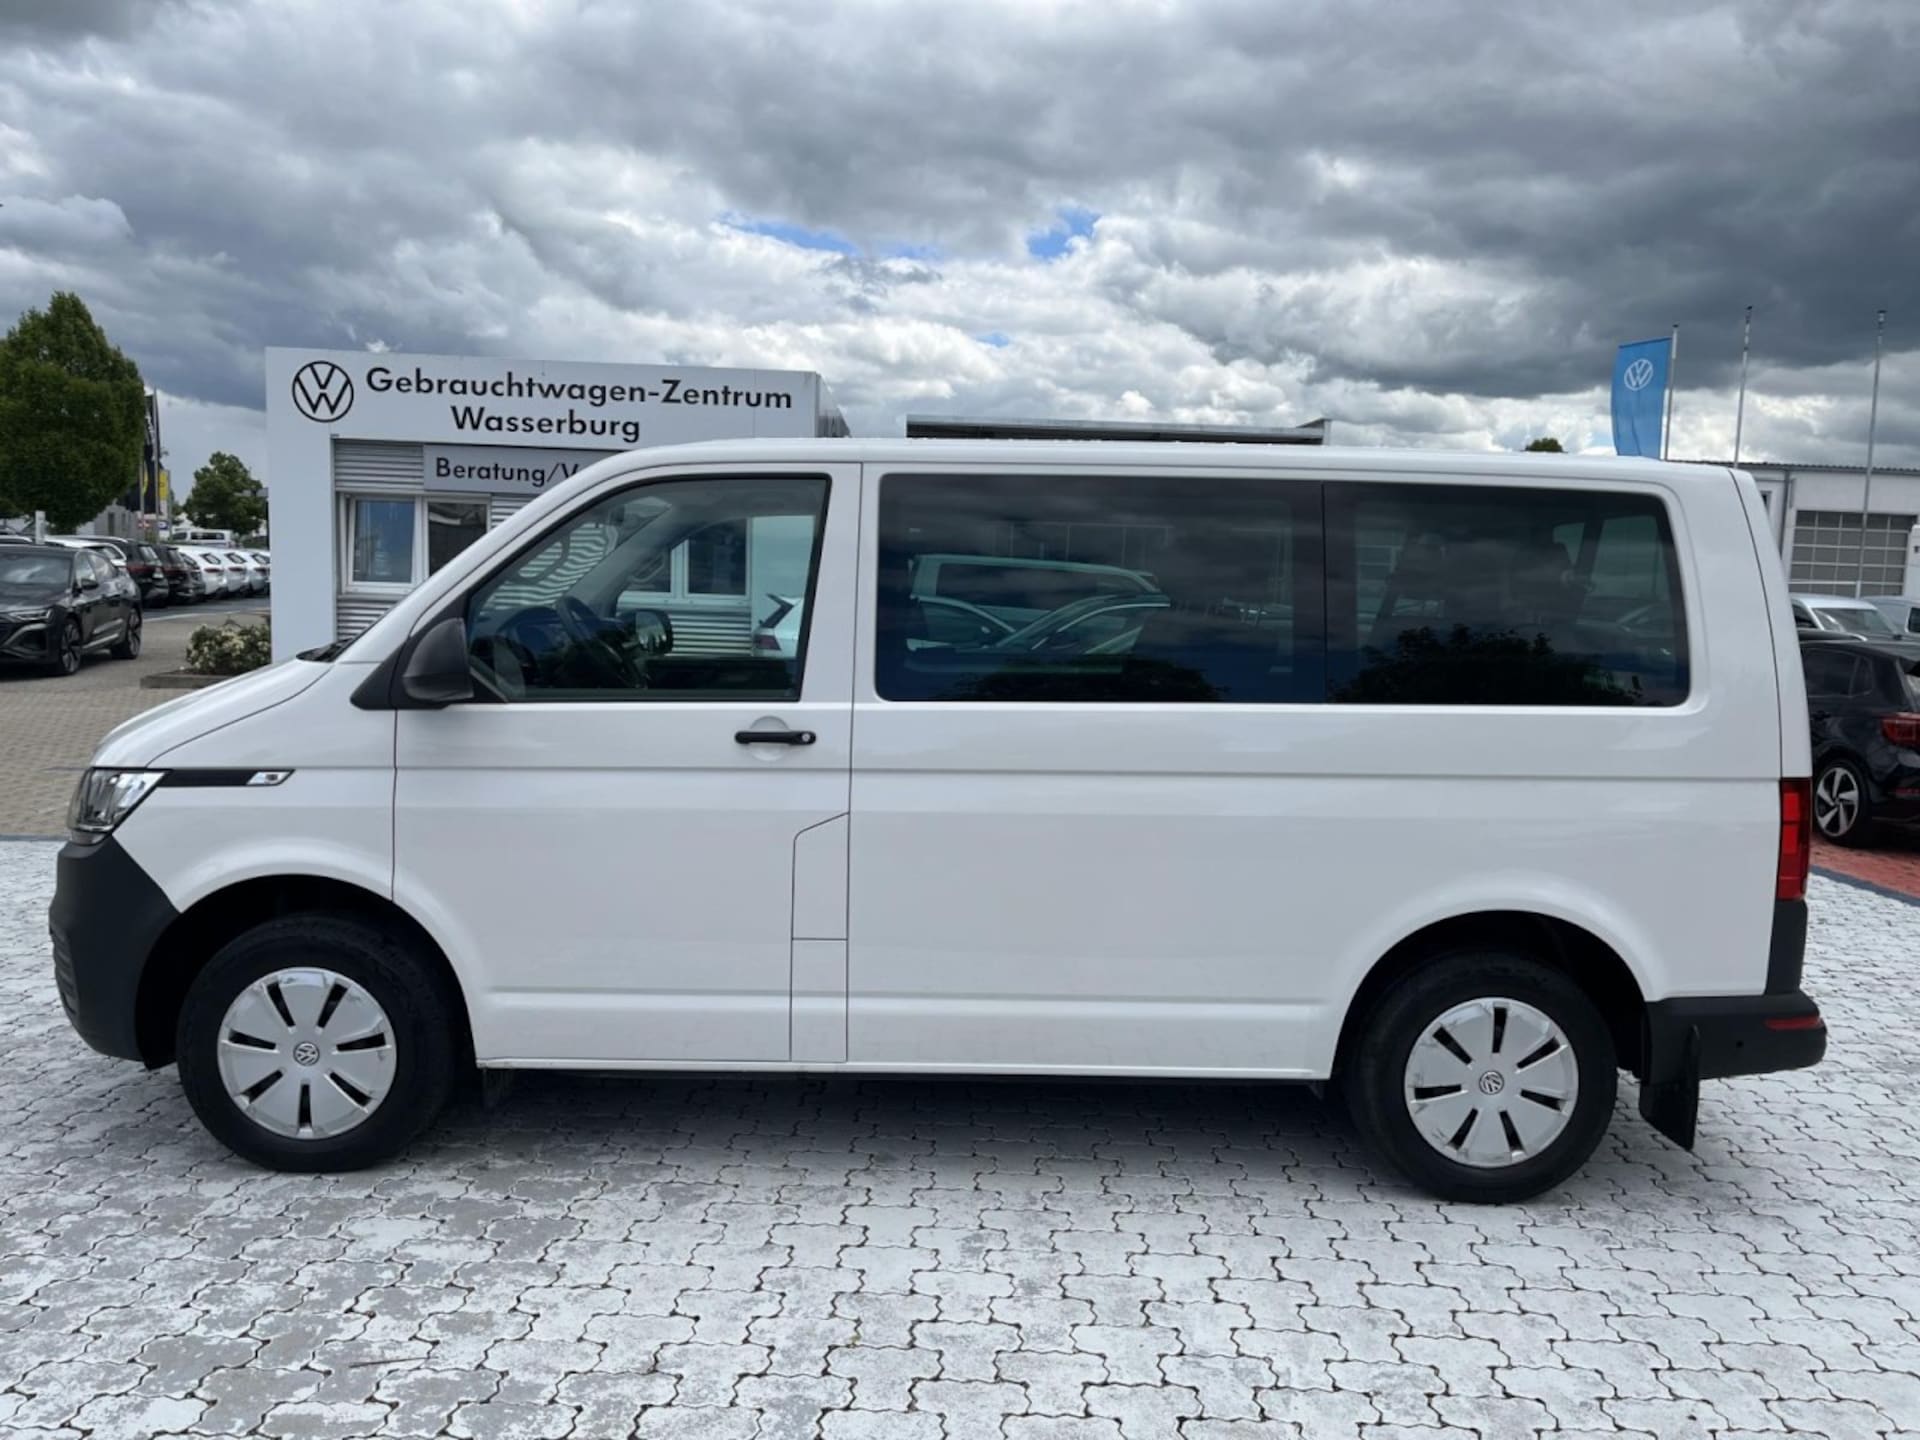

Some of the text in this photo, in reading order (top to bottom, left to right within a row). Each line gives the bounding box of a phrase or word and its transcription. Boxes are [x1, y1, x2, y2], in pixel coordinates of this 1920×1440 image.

[292, 360, 354, 422] VW
[366, 367, 792, 409] Gebrauchtwagen-Zentrum
[450, 405, 641, 443] Wasserburg
